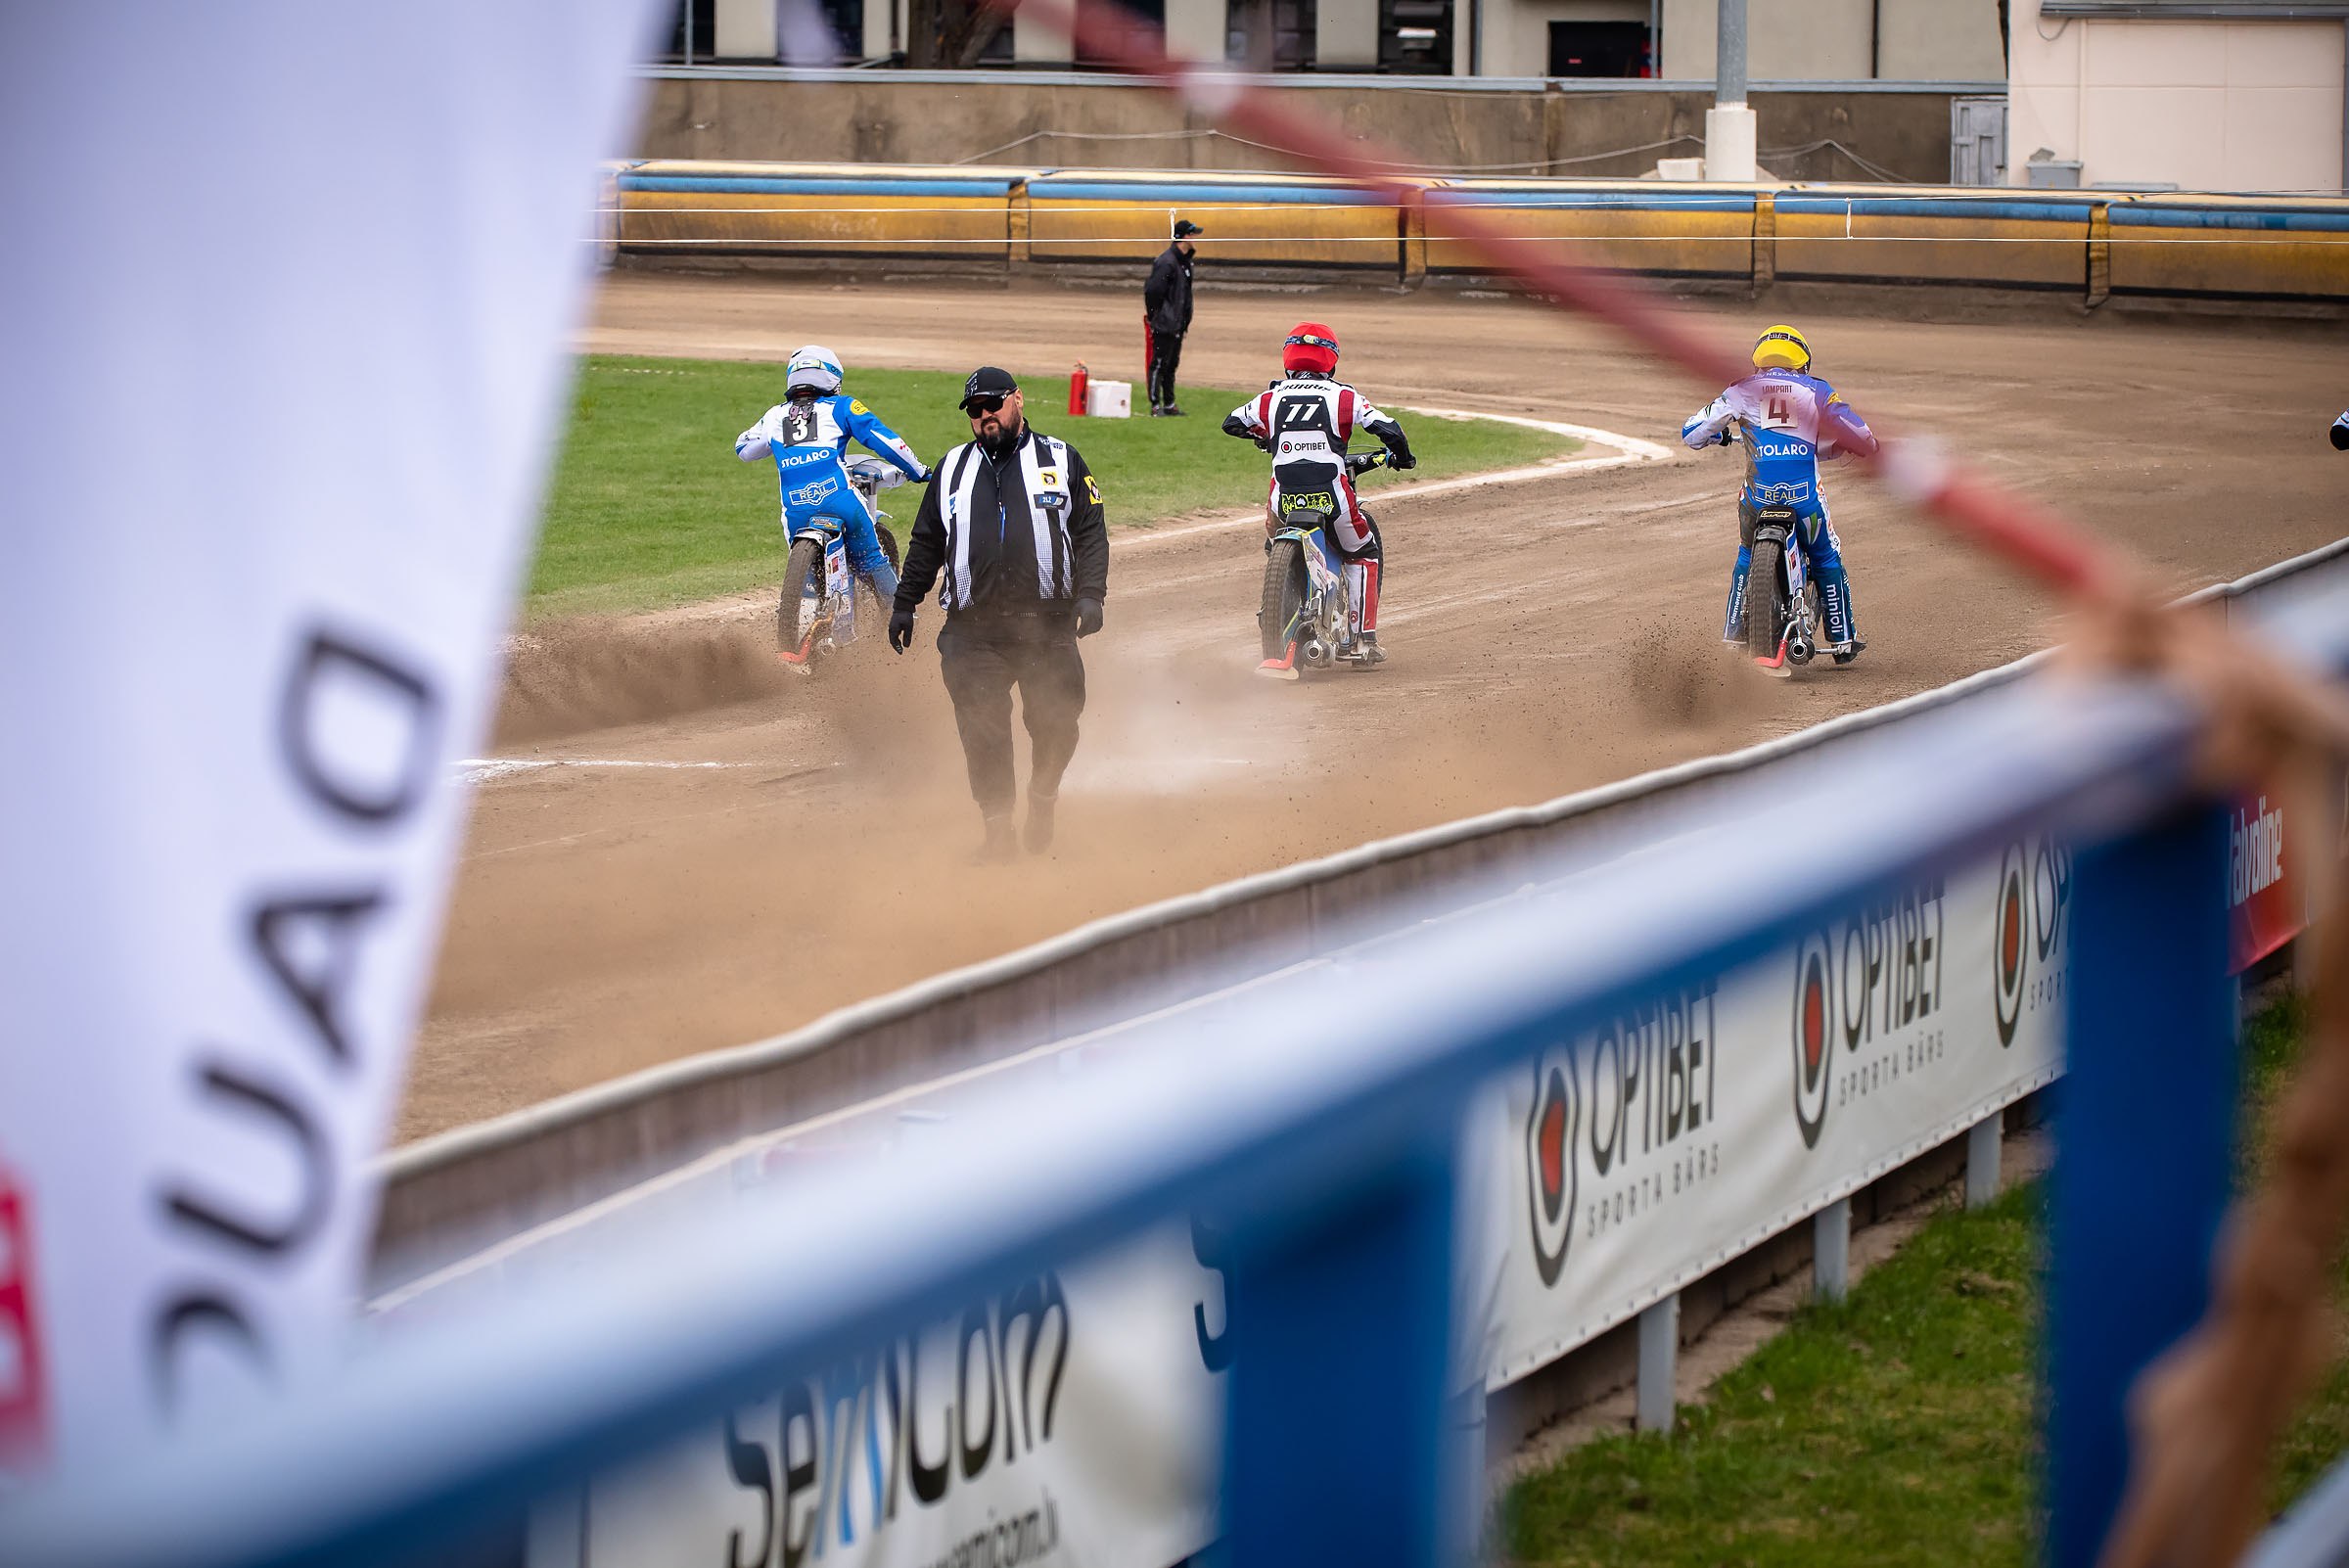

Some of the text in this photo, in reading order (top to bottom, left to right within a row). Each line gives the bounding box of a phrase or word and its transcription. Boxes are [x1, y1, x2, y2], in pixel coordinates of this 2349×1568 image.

[1768, 397, 1790, 424] 4
[792, 415, 808, 441] 3
[781, 449, 830, 469] STOLARO
[1294, 441, 1326, 451] OPTIBET
[799, 485, 829, 501] REALL
[1765, 490, 1799, 502] REALL
[1842, 881, 1946, 1052] OPTIBET
[1589, 984, 1719, 1176] OPTIBET
[1839, 1055, 1901, 1107] SPORTA
[1587, 1170, 1664, 1240] SPORTA
